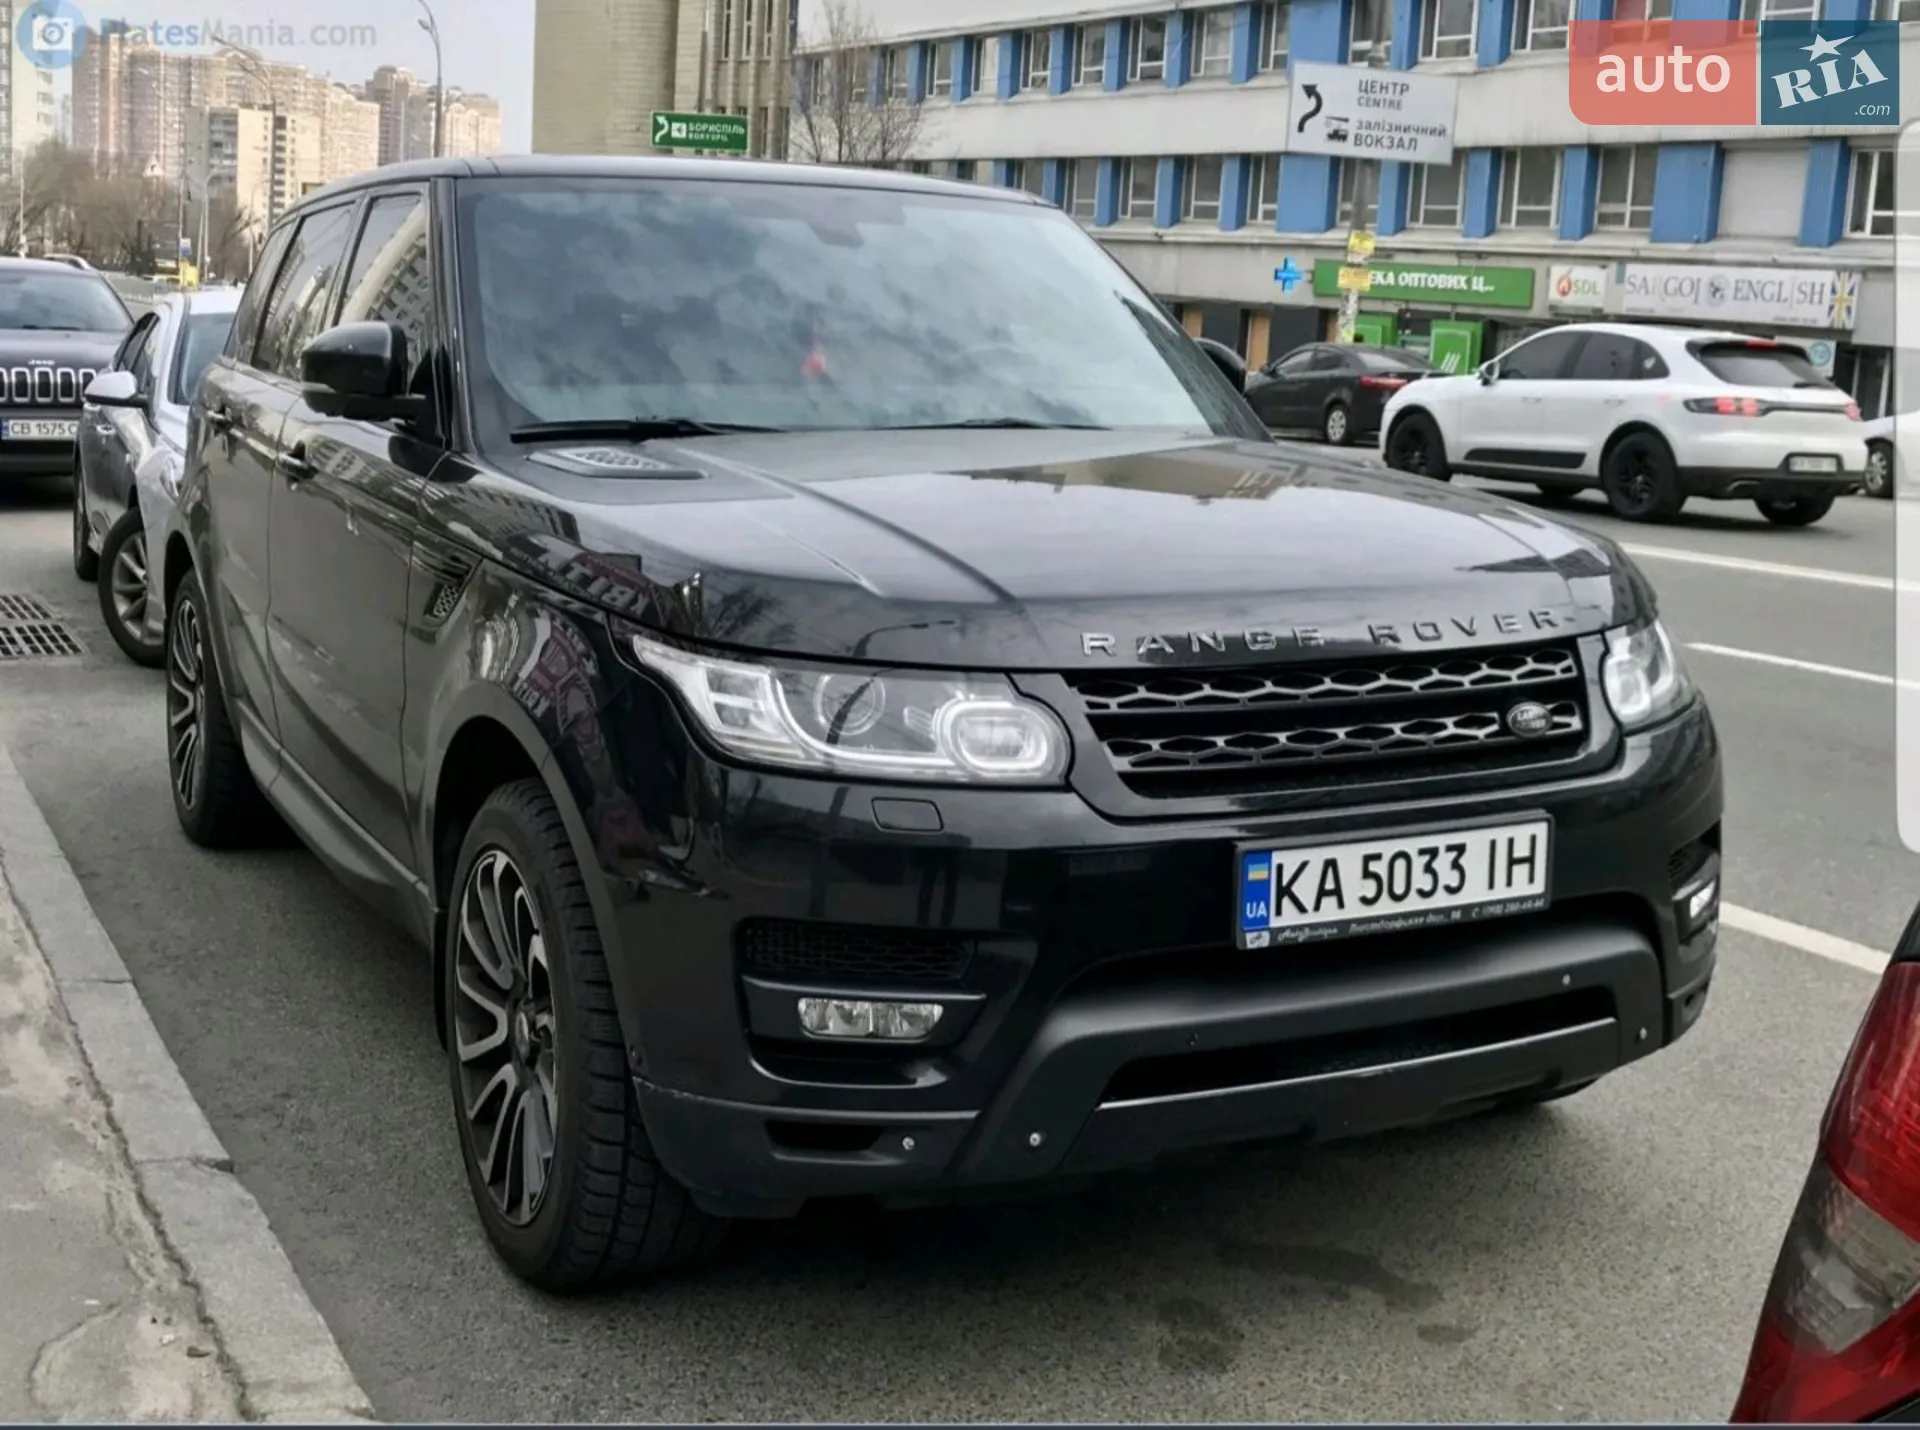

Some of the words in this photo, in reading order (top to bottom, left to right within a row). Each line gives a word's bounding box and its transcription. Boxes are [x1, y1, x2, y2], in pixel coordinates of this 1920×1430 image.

[1358, 79, 1410, 97] ЦЕНТР
[1357, 96, 1403, 111] CENTRE
[688, 121, 745, 135] БОРИСПІЛЬ
[1355, 118, 1447, 138] залізничний
[1353, 133, 1419, 152] ВОКЗАЛ
[1398, 271, 1469, 291] ОПТОВИХ
[1573, 278, 1601, 295] SDL
[68, 422, 78, 435] C
[1080, 625, 1326, 656] RANGE
[1367, 607, 1562, 647] ROVER
[1274, 857, 1346, 918] KA
[1357, 841, 1467, 907] 5033
[1487, 833, 1537, 890] IH
[1245, 900, 1268, 919] UA
